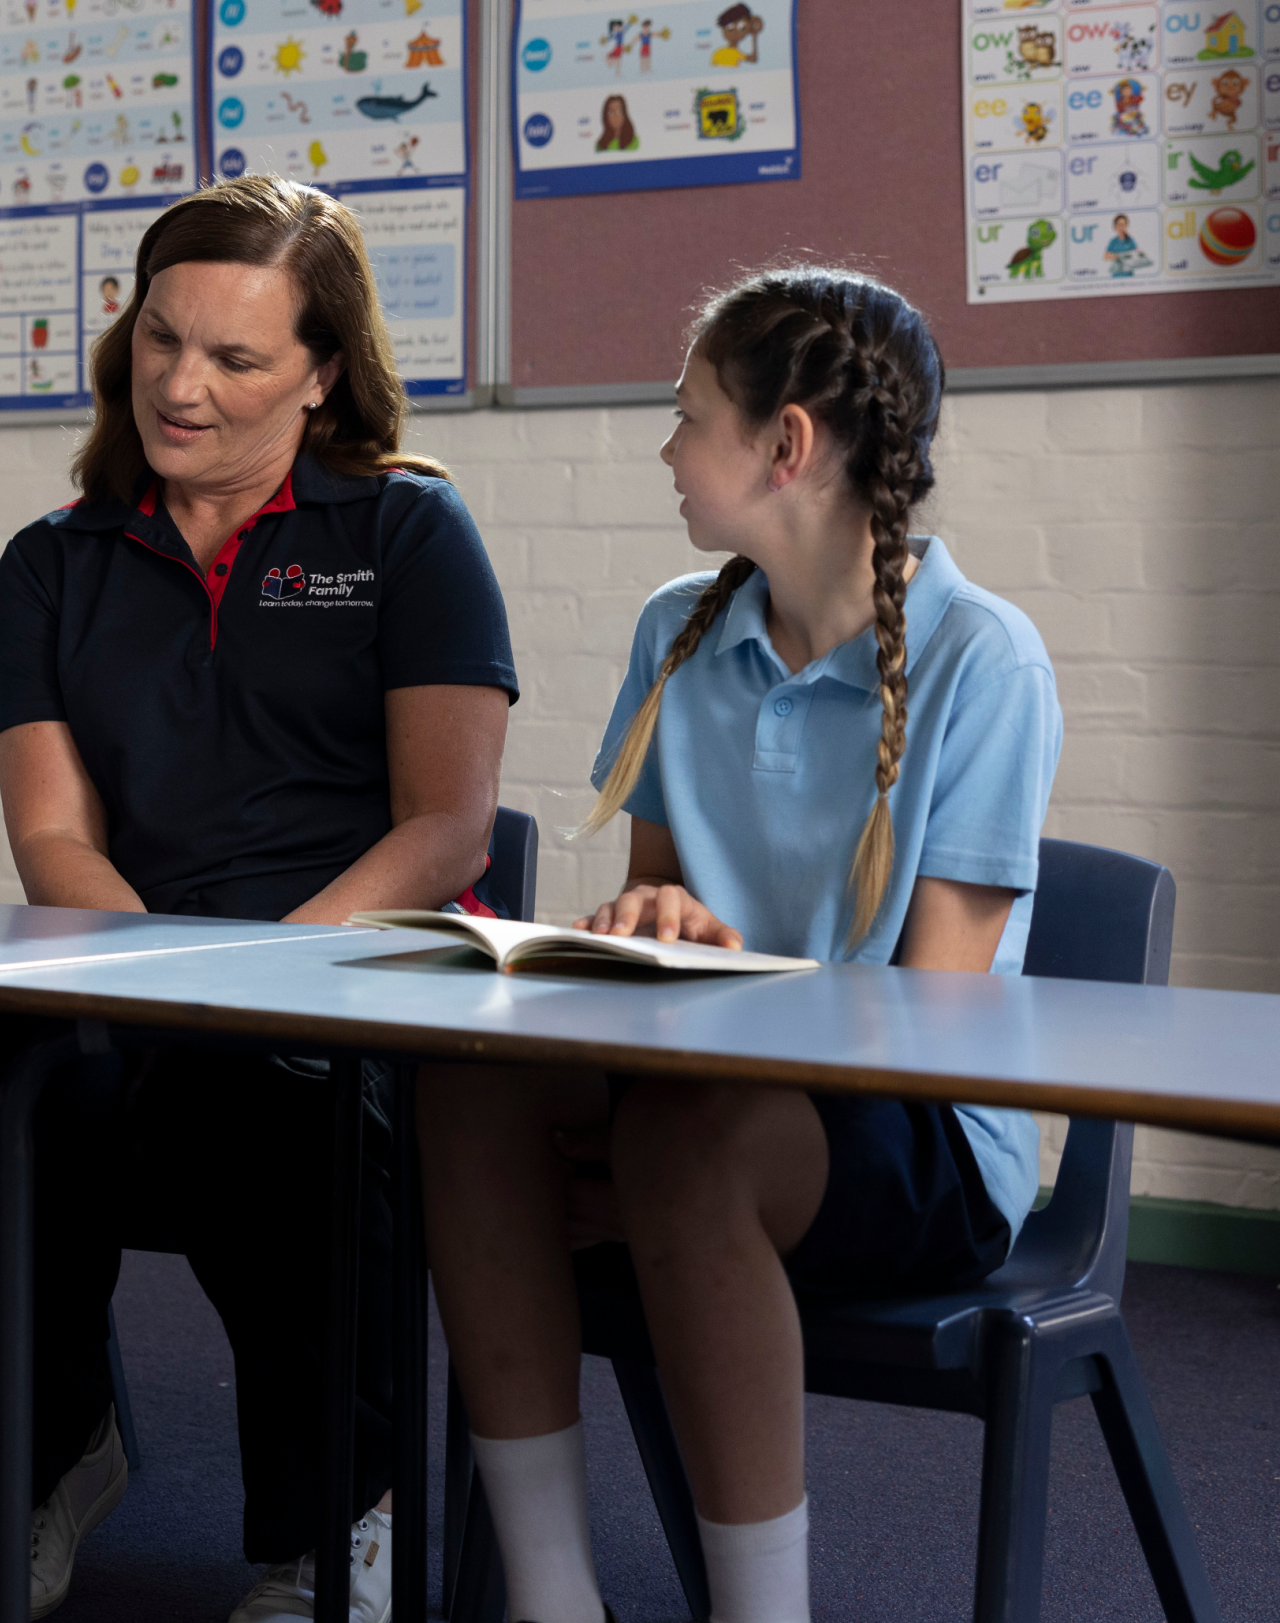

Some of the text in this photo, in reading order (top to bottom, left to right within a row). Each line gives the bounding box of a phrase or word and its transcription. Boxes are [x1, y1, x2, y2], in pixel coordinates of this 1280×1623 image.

[1068, 21, 1109, 42] ow
[1165, 12, 1200, 33] ou
[973, 31, 1014, 51] ow
[1069, 90, 1102, 110] ee
[1166, 81, 1197, 108] ey
[973, 98, 1007, 118] ee
[1069, 155, 1098, 176] er
[1168, 144, 1184, 169] ir
[975, 163, 1003, 183] er
[977, 223, 1003, 243] ur
[1071, 223, 1098, 244] ur
[1168, 211, 1197, 240] all
[309, 569, 375, 584] The Smith
[308, 583, 354, 598] Family
[281, 600, 304, 608] today,
[305, 600, 334, 608] change
